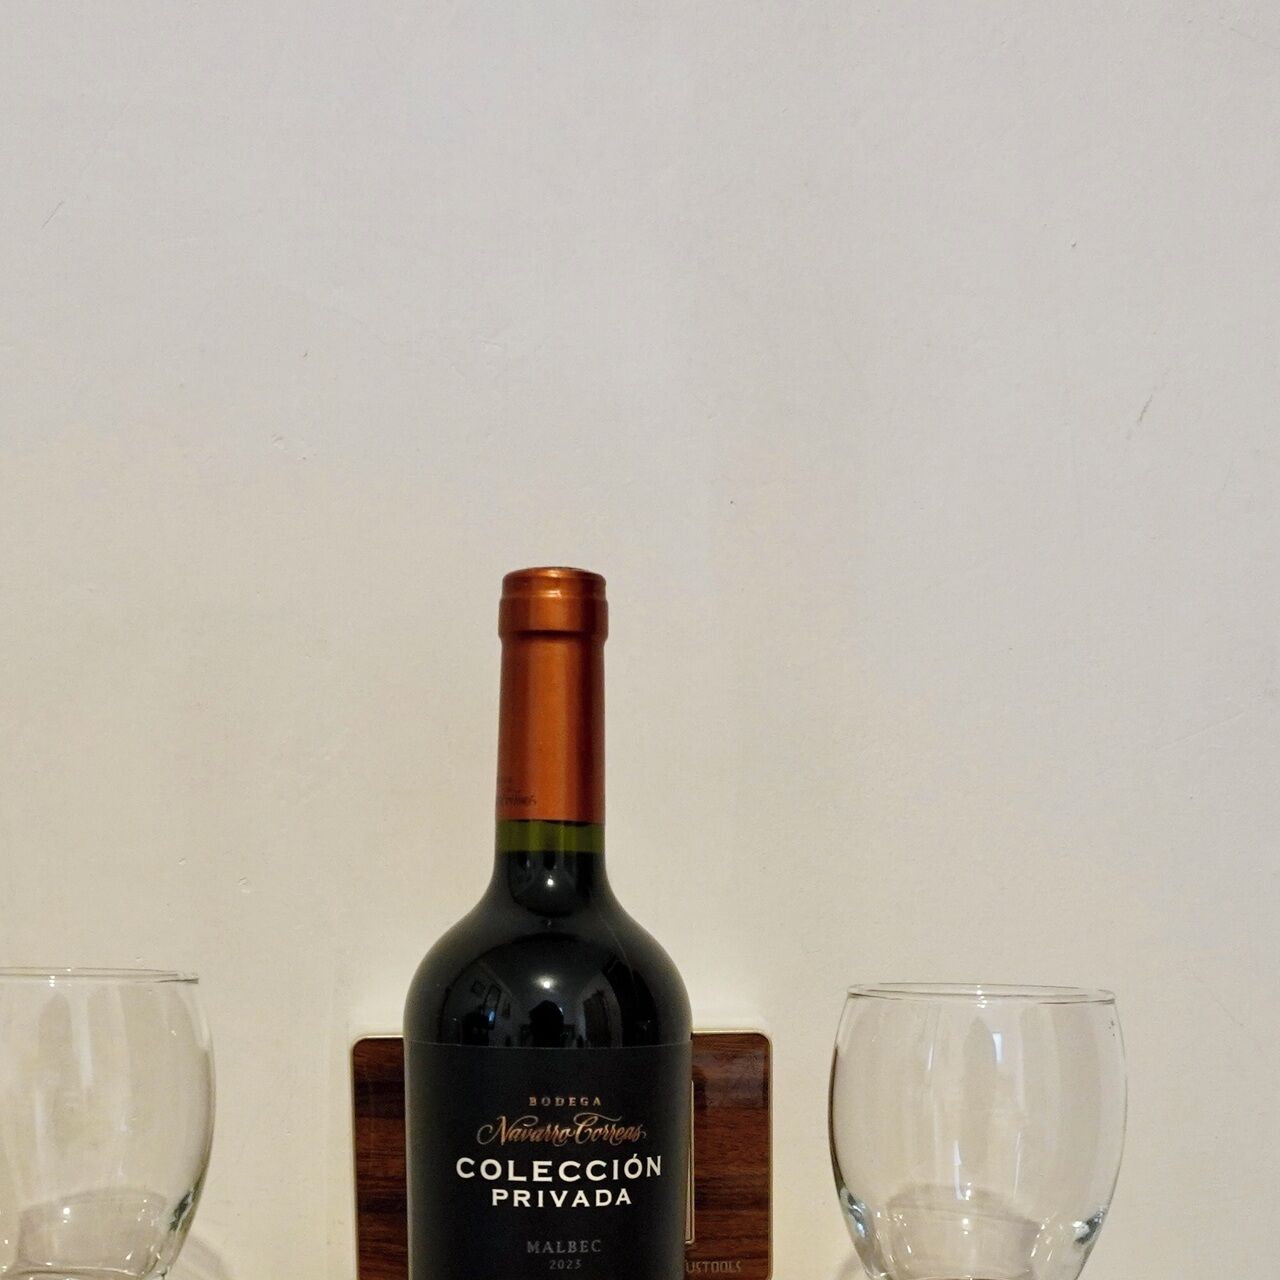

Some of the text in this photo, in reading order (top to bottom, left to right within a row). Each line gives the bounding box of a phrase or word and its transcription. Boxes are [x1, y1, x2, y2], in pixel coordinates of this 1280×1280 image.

[528, 1096, 602, 1107] BODEGA
[476, 1111, 648, 1148] Navarro Correas
[455, 1152, 663, 1184] COLECCIÓN
[490, 1187, 633, 1209] PRIVADA
[526, 1238, 602, 1255] MALBEC
